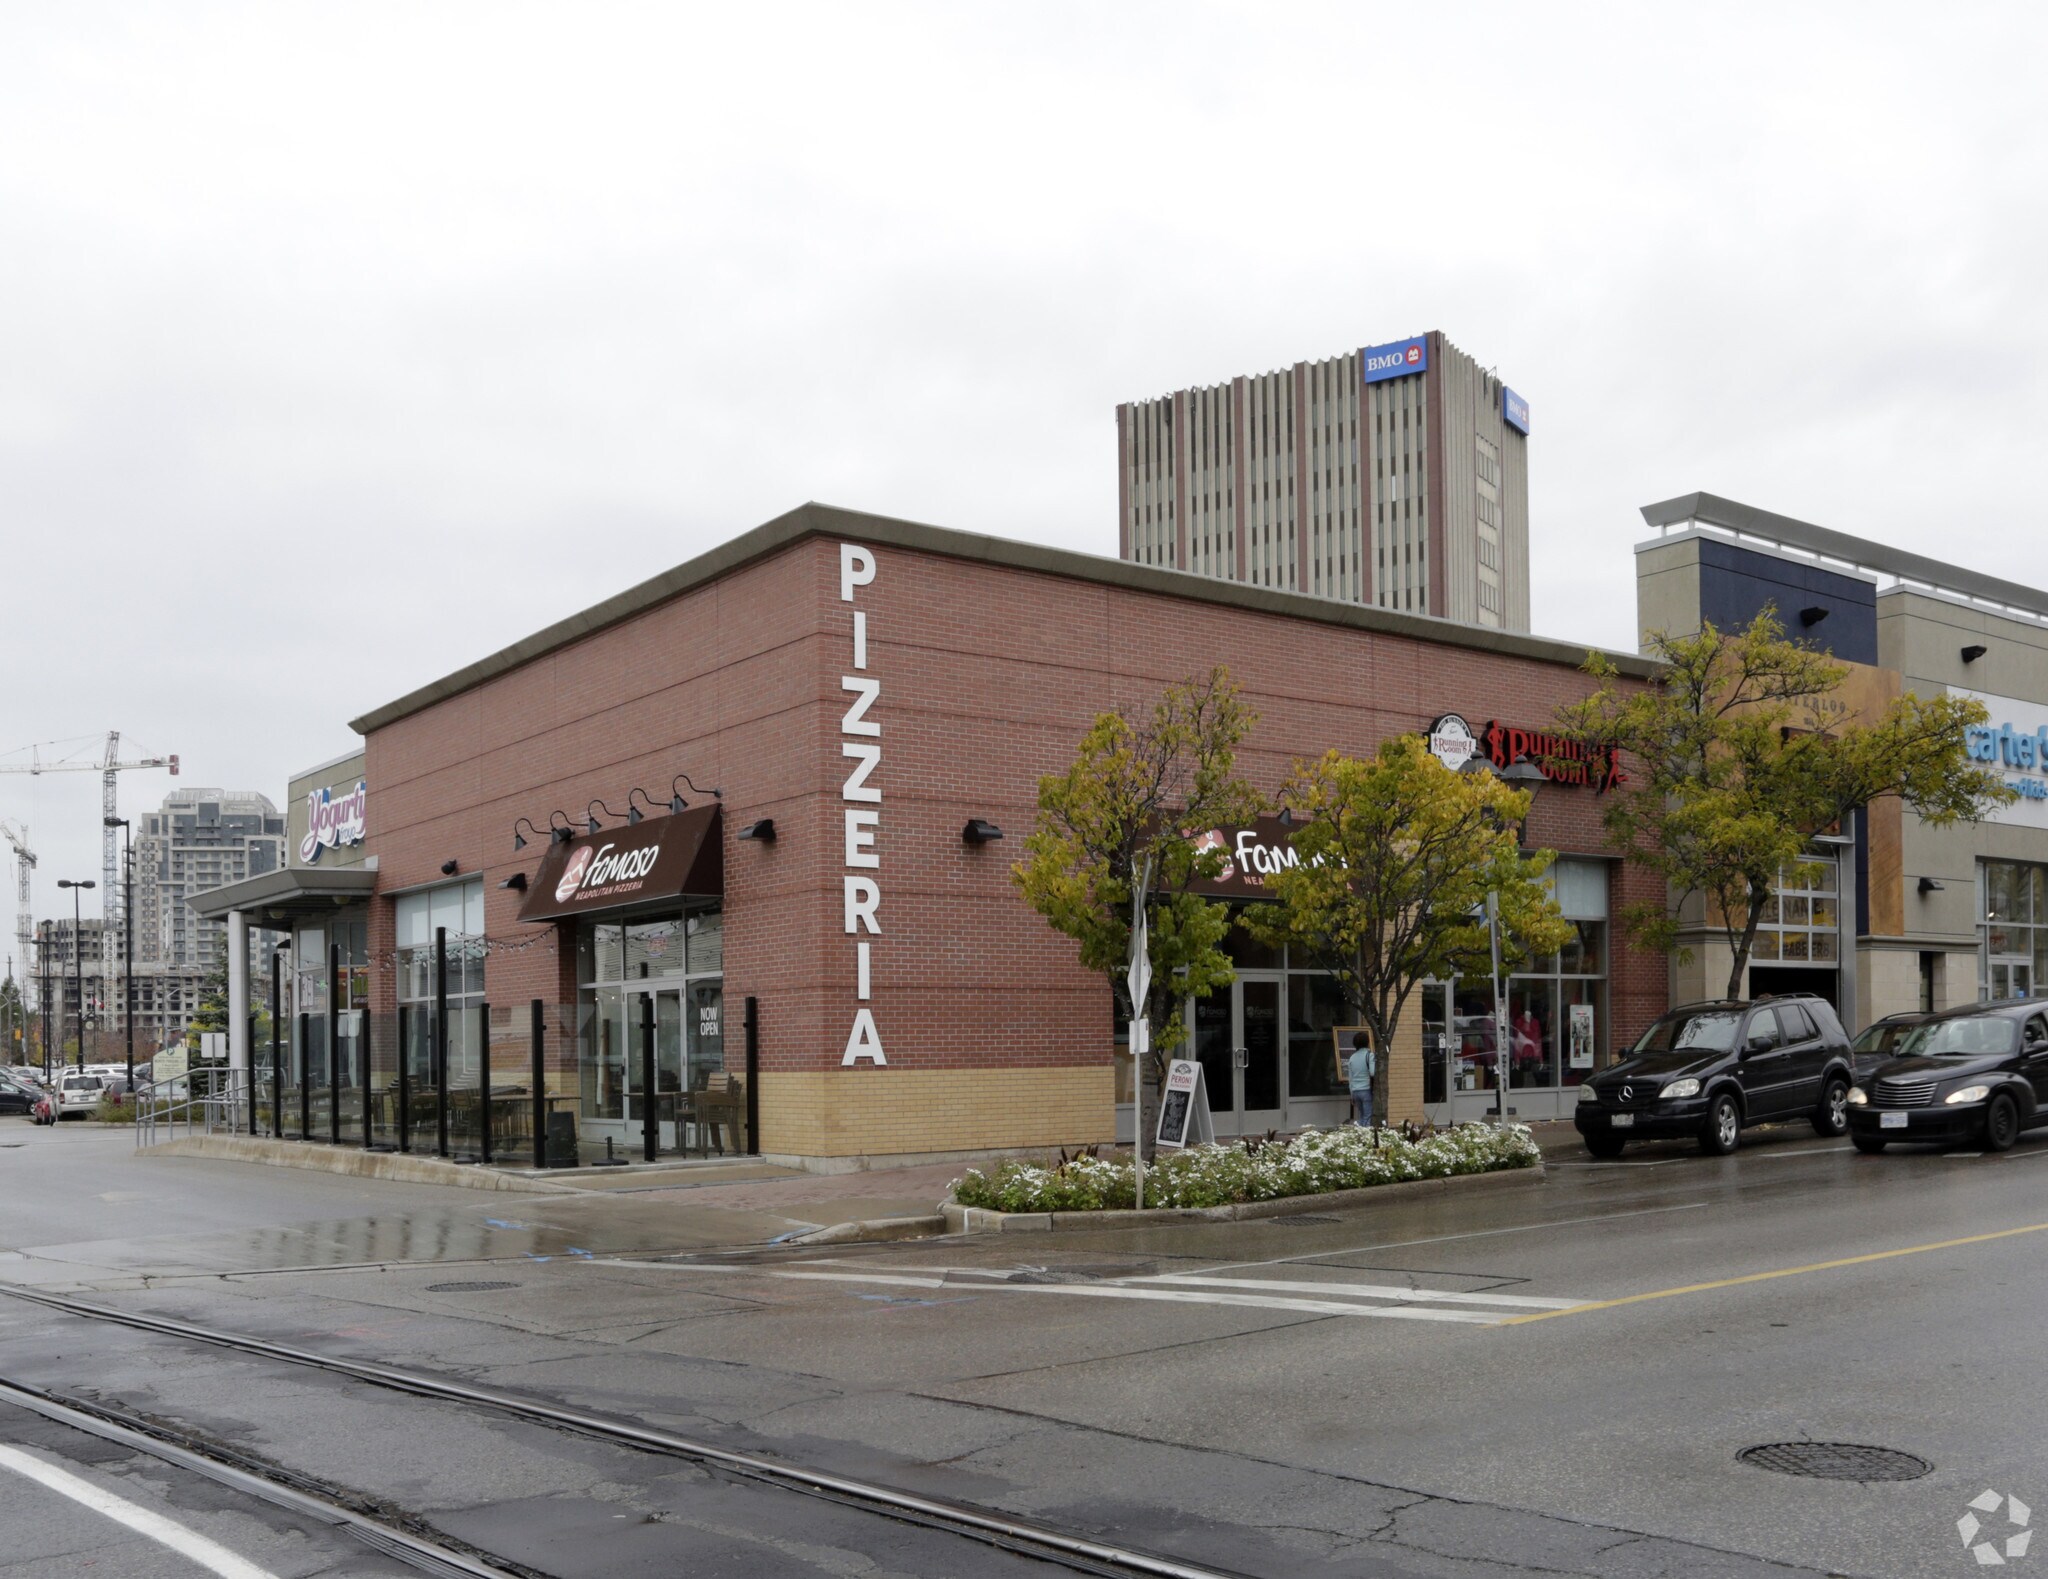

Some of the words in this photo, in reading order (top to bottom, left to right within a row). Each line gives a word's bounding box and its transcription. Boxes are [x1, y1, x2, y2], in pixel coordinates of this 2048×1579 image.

[1367, 352, 1403, 372] BMO
[1509, 399, 1522, 418] BMO
[840, 542, 888, 1067] PIZZERIA
[1235, 830, 1348, 874] Fam
[574, 886, 614, 901] NEAPOLITAN
[613, 880, 644, 894] PIZZERIA
[700, 1006, 718, 1021] NOW
[700, 1022, 719, 1036] OPEN
[1171, 1074, 1193, 1085] PERONI
